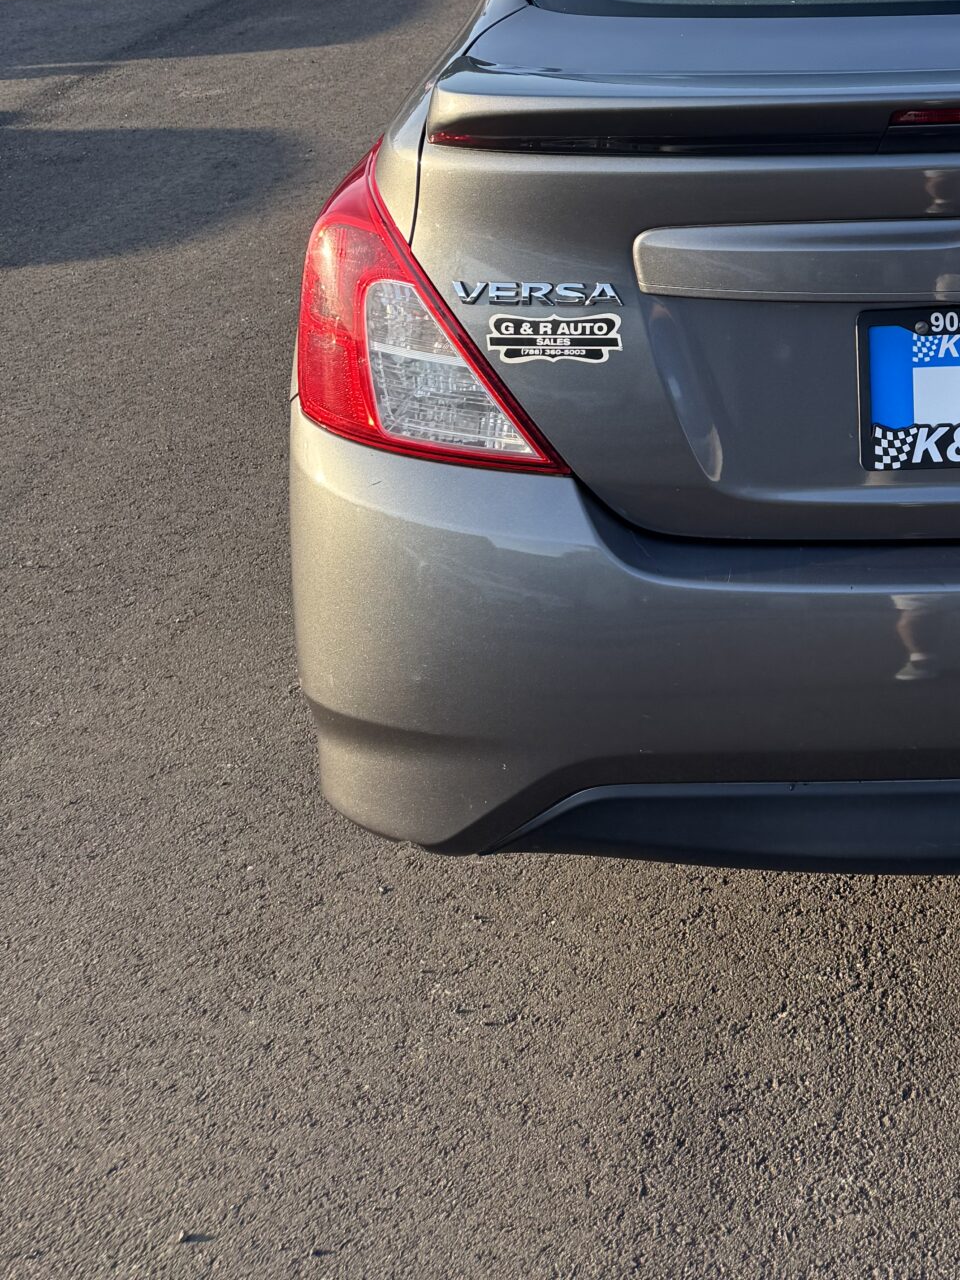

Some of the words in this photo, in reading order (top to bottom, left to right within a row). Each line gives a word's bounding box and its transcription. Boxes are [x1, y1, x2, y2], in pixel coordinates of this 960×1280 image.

[452, 281, 625, 306] VERSA
[501, 322, 515, 335] G
[519, 322, 533, 335] &
[539, 322, 552, 334] R
[557, 322, 608, 335] AUTO
[536, 338, 571, 346] SALES
